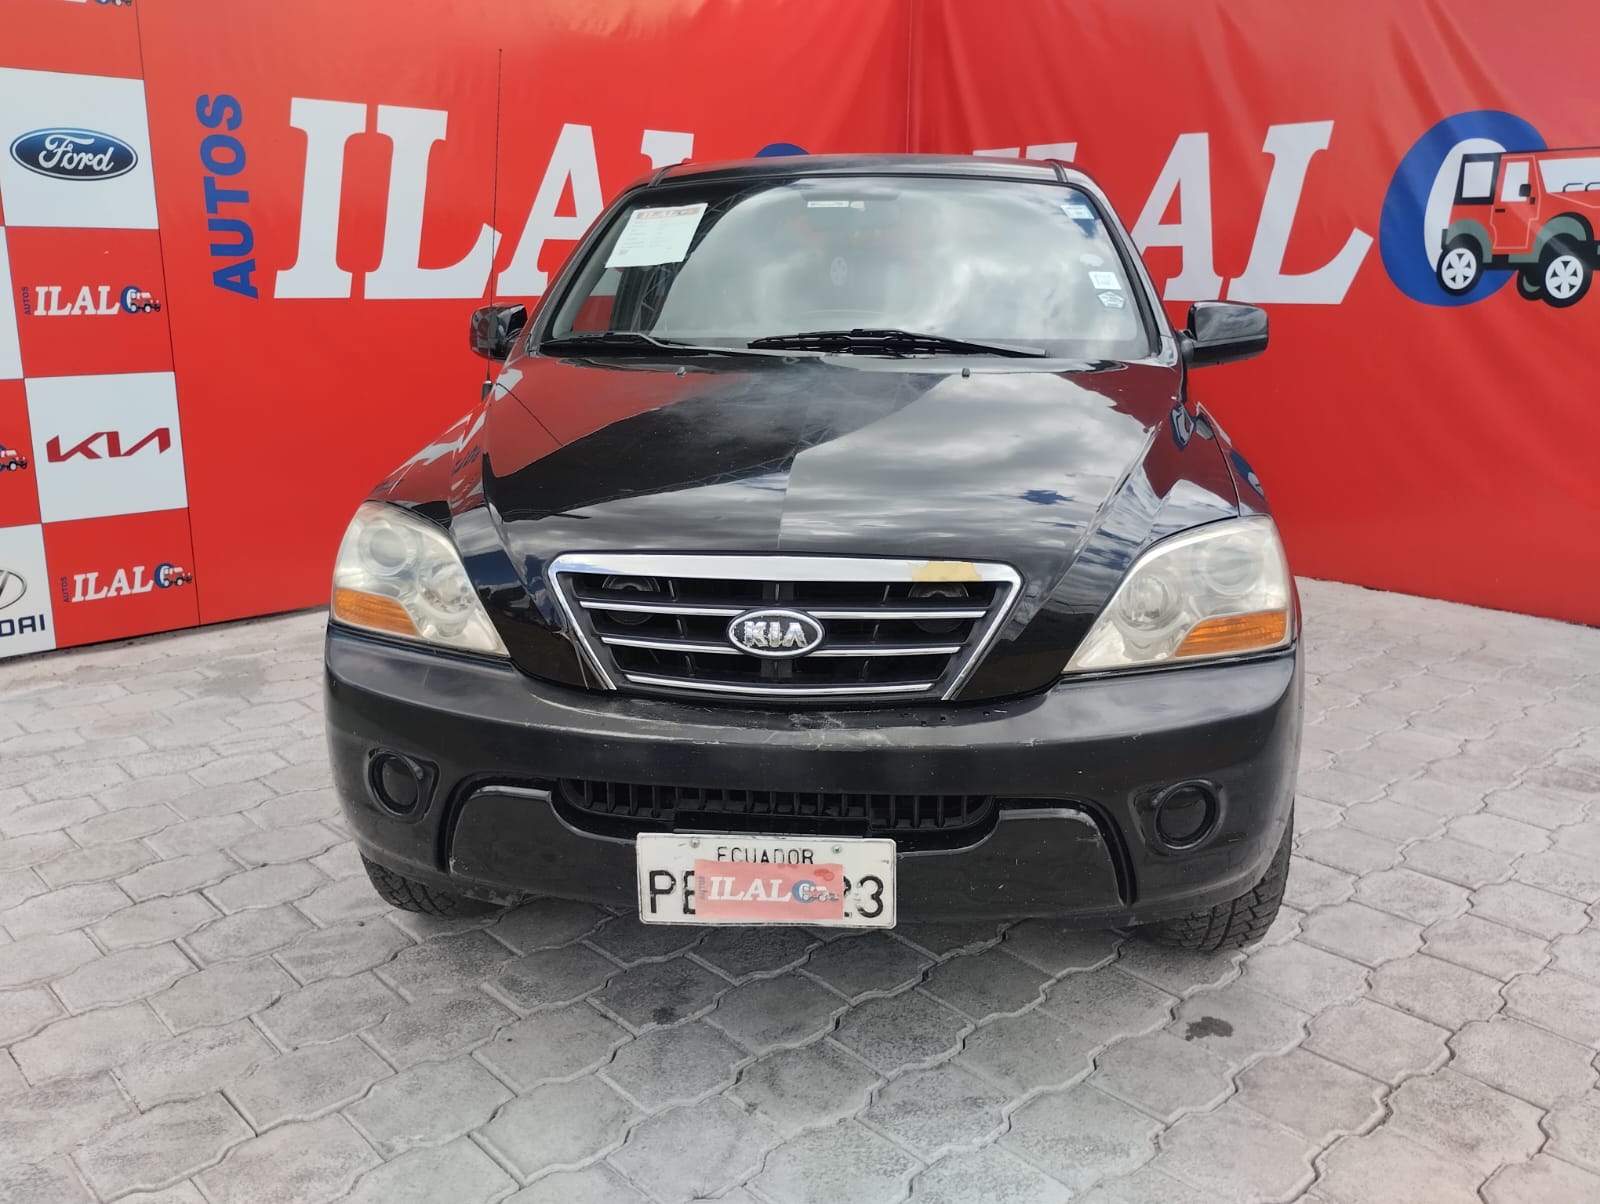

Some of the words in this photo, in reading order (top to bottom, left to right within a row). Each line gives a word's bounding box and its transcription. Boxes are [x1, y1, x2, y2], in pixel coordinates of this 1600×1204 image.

[38, 134, 114, 172] Ford
[195, 94, 258, 299] AUTOS
[46, 427, 171, 463] KIA
[0, 613, 46, 637] DAI
[743, 620, 808, 648] KIA
[716, 846, 814, 865] ECUADOR
